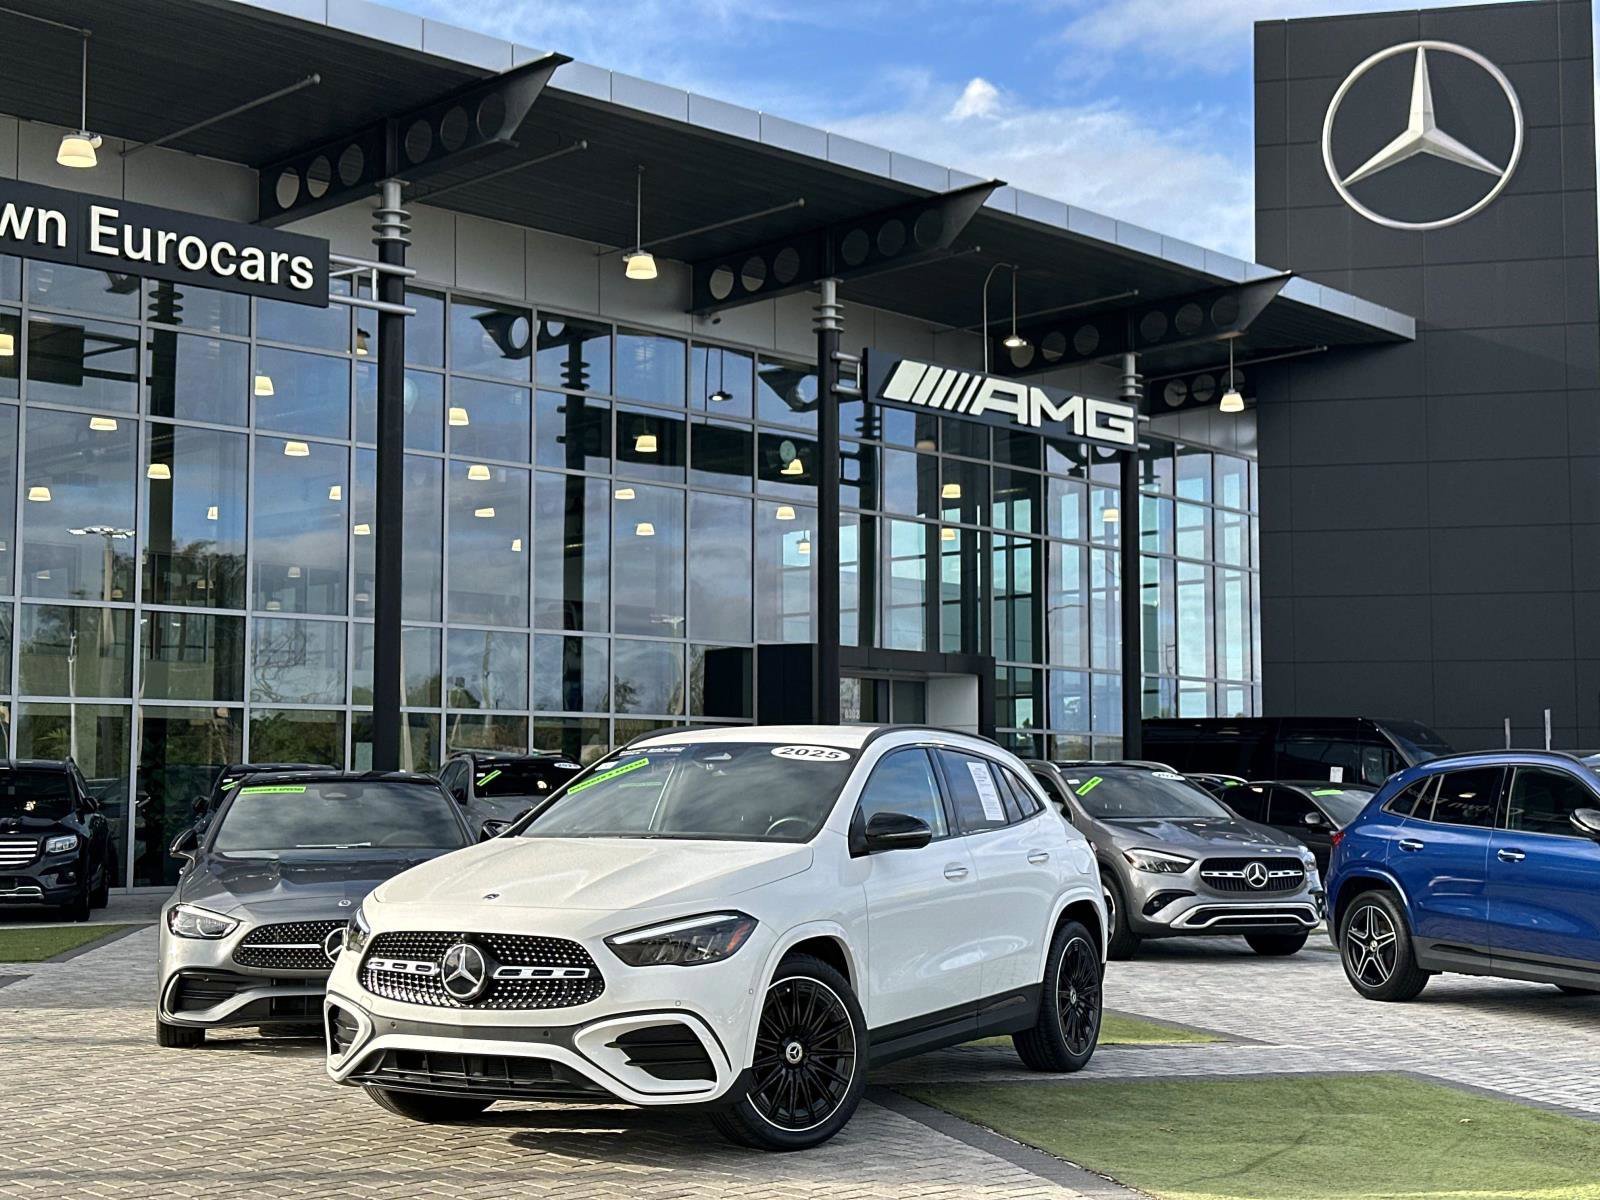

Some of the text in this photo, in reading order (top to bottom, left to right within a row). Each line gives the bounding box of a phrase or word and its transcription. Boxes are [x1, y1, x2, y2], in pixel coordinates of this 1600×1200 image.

[0, 202, 314, 290] wn Eurocars
[968, 377, 1135, 446] AMG
[778, 747, 842, 759] 2025
